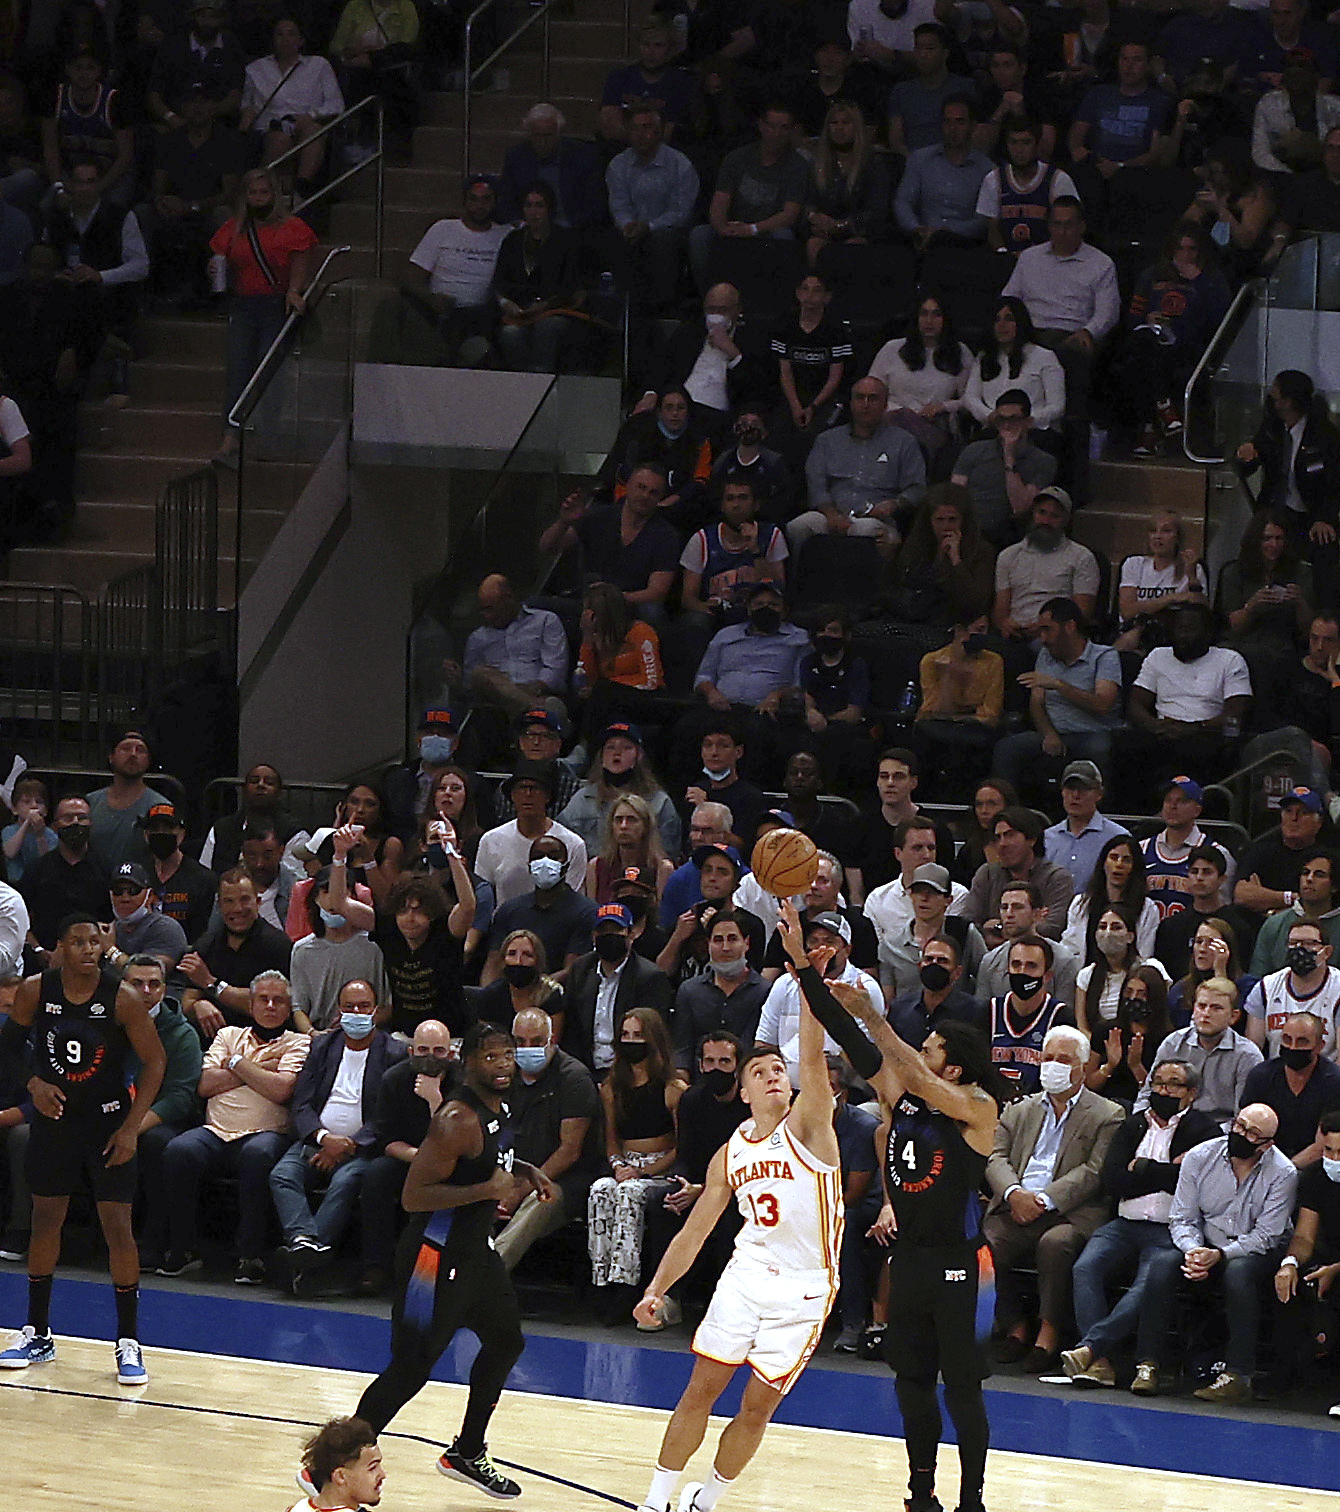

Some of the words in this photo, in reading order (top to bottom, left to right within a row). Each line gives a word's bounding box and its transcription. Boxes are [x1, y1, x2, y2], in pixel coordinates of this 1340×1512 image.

[66, 1040, 83, 1065] 9
[901, 1139, 918, 1171] 4
[729, 1160, 795, 1192] ATLANTA
[747, 1192, 780, 1227] 13
